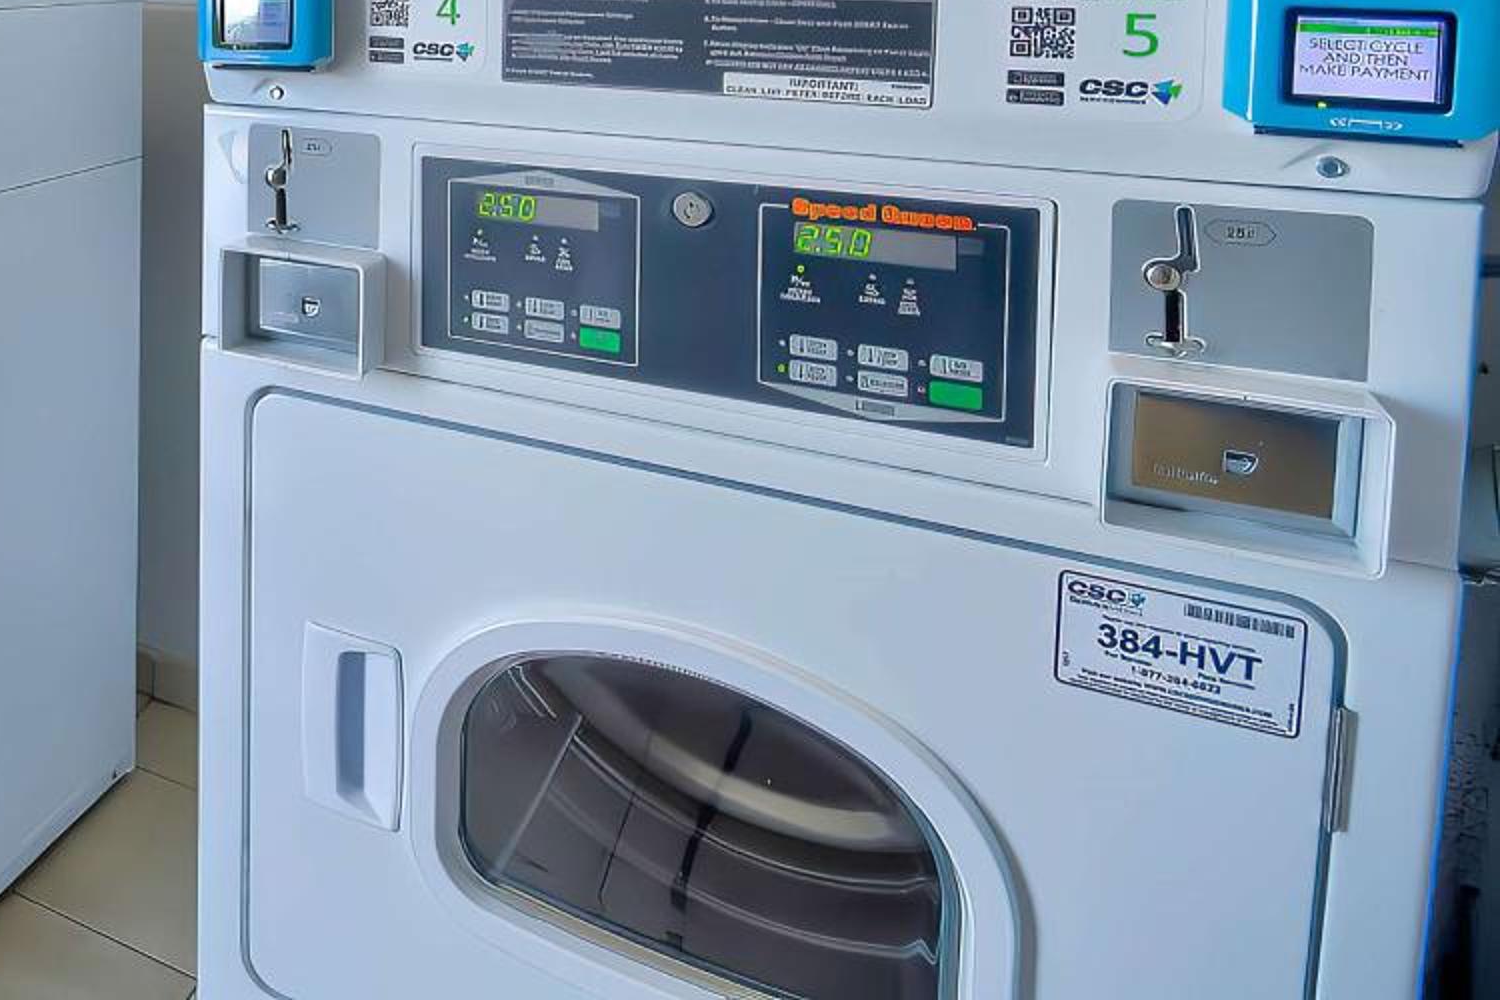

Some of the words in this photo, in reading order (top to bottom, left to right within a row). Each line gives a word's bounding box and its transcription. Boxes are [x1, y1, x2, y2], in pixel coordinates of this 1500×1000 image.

[1122, 13, 1160, 57] 5
[1308, 37, 1367, 52] SELECT
[1368, 39, 1425, 55] CYCLE
[413, 41, 455, 58] CSC
[1323, 52, 1362, 65] AND
[1365, 53, 1409, 67] THEN
[1299, 63, 1346, 77] MAKE
[1350, 65, 1430, 81] PAYMENT
[1078, 78, 1149, 98] CSC
[477, 193, 536, 223] 2.50
[792, 197, 877, 222] Speed
[881, 204, 974, 232] Queen
[796, 213, 874, 258] 2.50
[1067, 579, 1127, 603] CSC
[1097, 623, 1262, 681] 384-HVT
